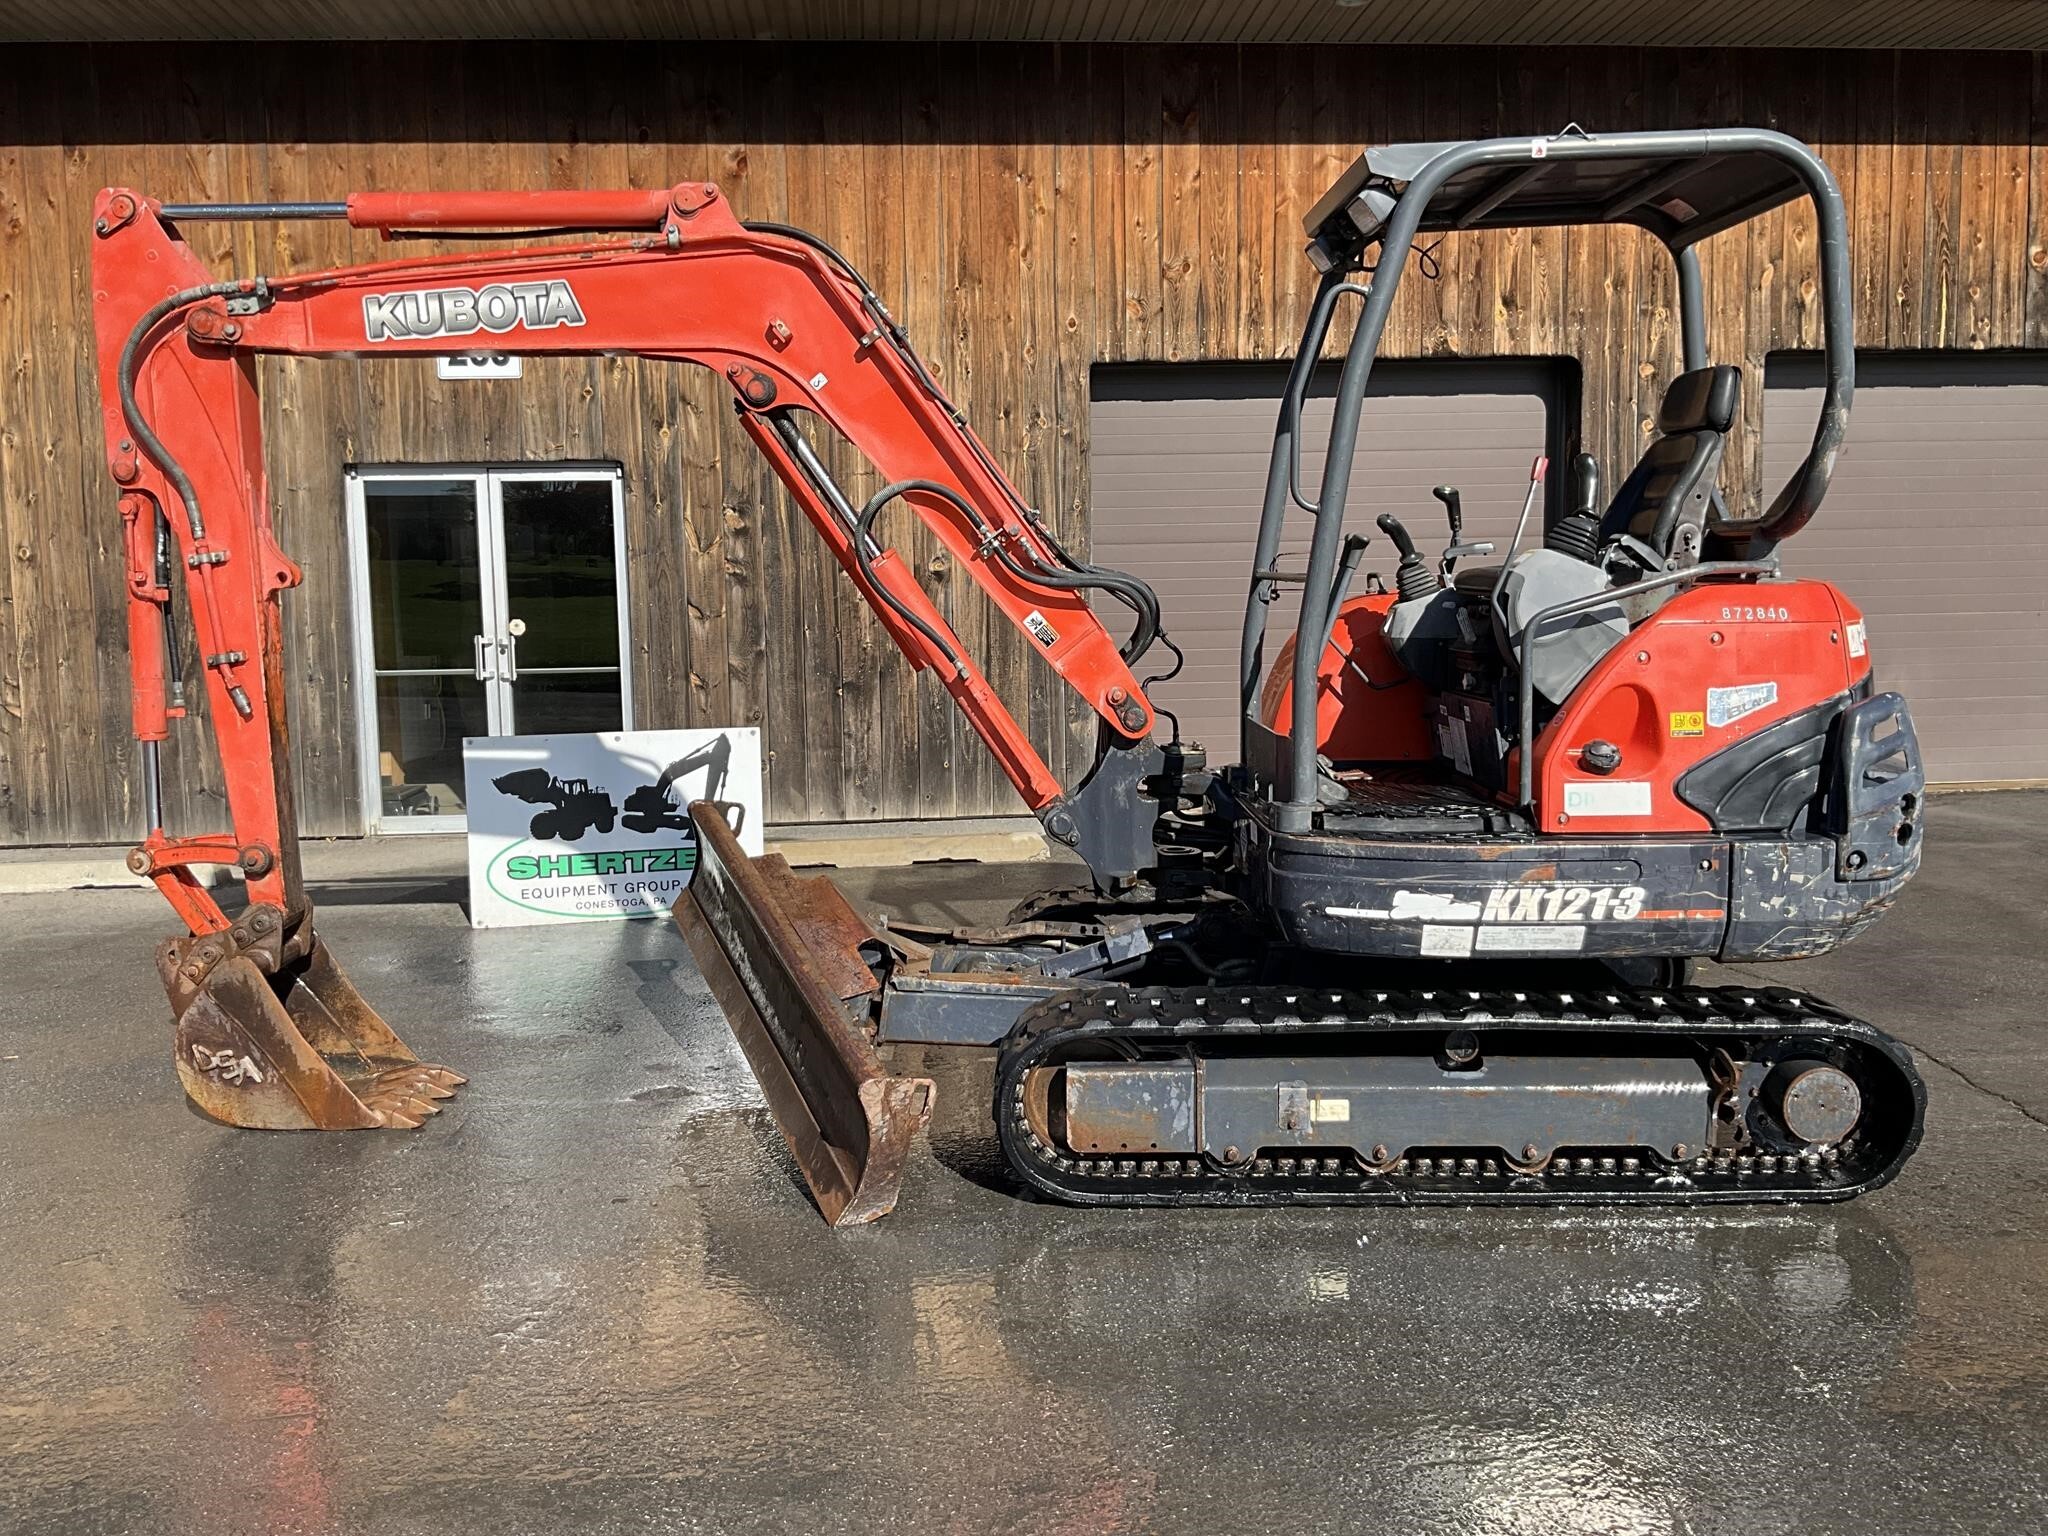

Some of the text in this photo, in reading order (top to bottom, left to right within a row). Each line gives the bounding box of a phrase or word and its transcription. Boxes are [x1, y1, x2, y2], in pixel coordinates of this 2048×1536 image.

[364, 280, 585, 340] KUBOTA
[1722, 607, 1788, 620] 872840
[507, 847, 697, 880] SHERTZE
[521, 883, 615, 900] EQUIPMENT
[1482, 886, 1646, 921] KX121-3
[575, 897, 667, 912] CONESTOGA, PA
